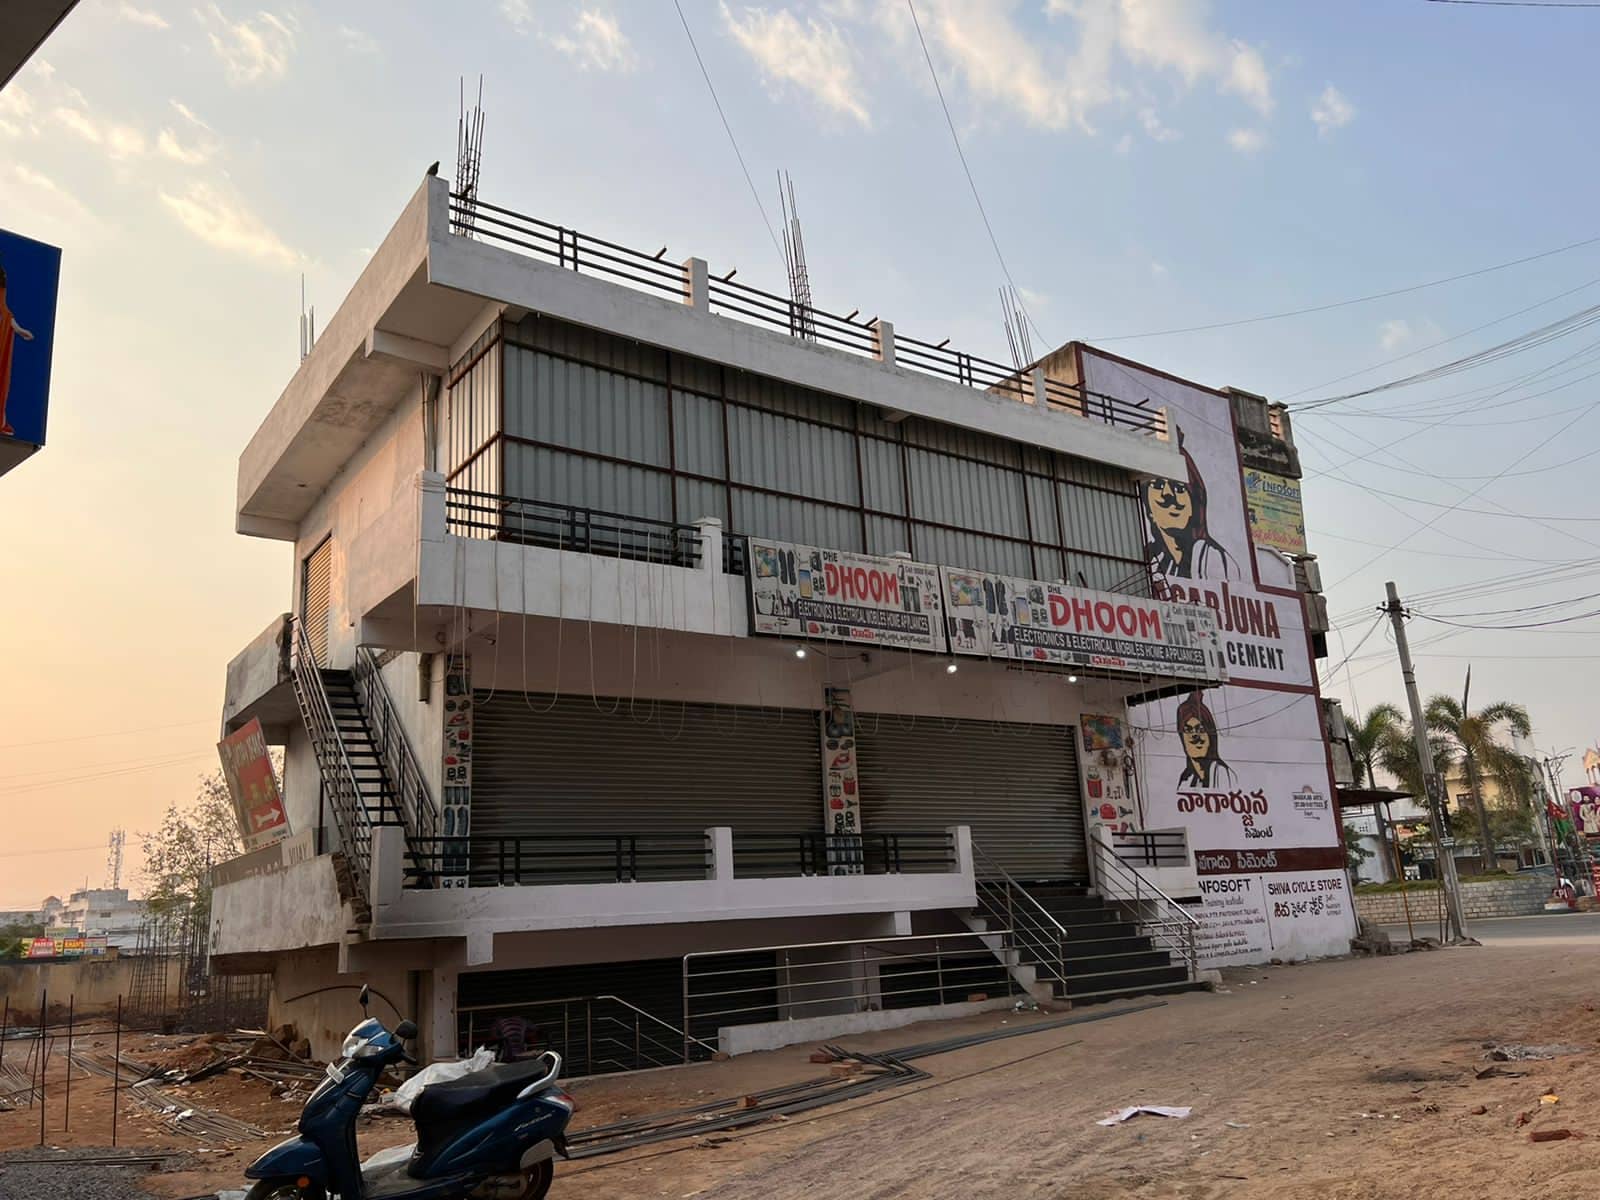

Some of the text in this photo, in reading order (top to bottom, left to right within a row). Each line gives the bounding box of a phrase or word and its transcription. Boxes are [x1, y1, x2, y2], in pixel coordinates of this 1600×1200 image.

[824, 563, 900, 605] DHOOM
[1048, 594, 1163, 641] DHOOM
[1014, 630, 1065, 648] ELECTRONICS
[1072, 636, 1115, 653] ELECTRICAL
[1145, 645, 1165, 659] HOME
[1165, 647, 1204, 663] APPLIANCES
[1226, 641, 1284, 671] CEMENT
[1198, 878, 1251, 894] NFOSOFT
[1268, 878, 1342, 896] SHIVA CYCLE STORE
